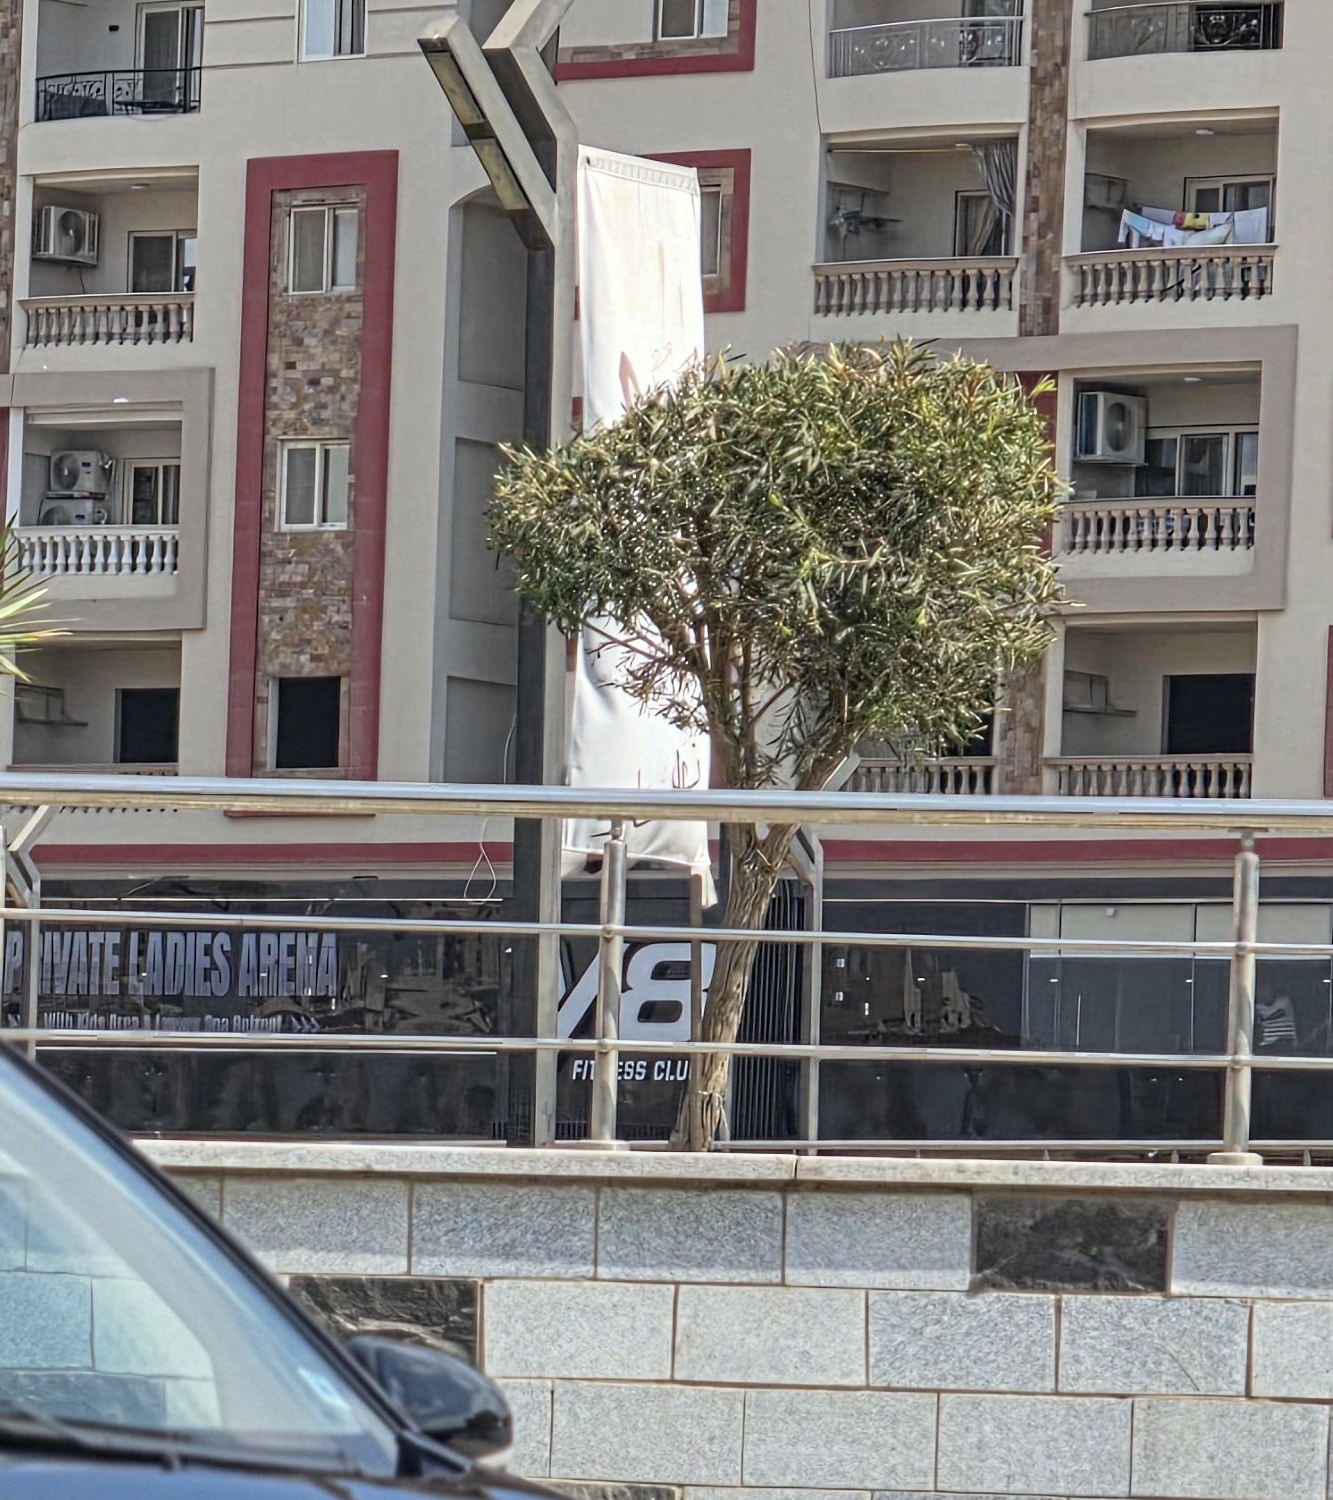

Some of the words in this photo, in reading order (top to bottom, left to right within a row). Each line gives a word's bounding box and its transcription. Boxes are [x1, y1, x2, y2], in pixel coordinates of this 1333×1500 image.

[4, 931, 120, 995] PIVATE
[129, 931, 231, 996] LADIES
[238, 932, 337, 997] ARENA
[572, 1059, 647, 1081] FITESS
[653, 1060, 692, 1081] CLU
